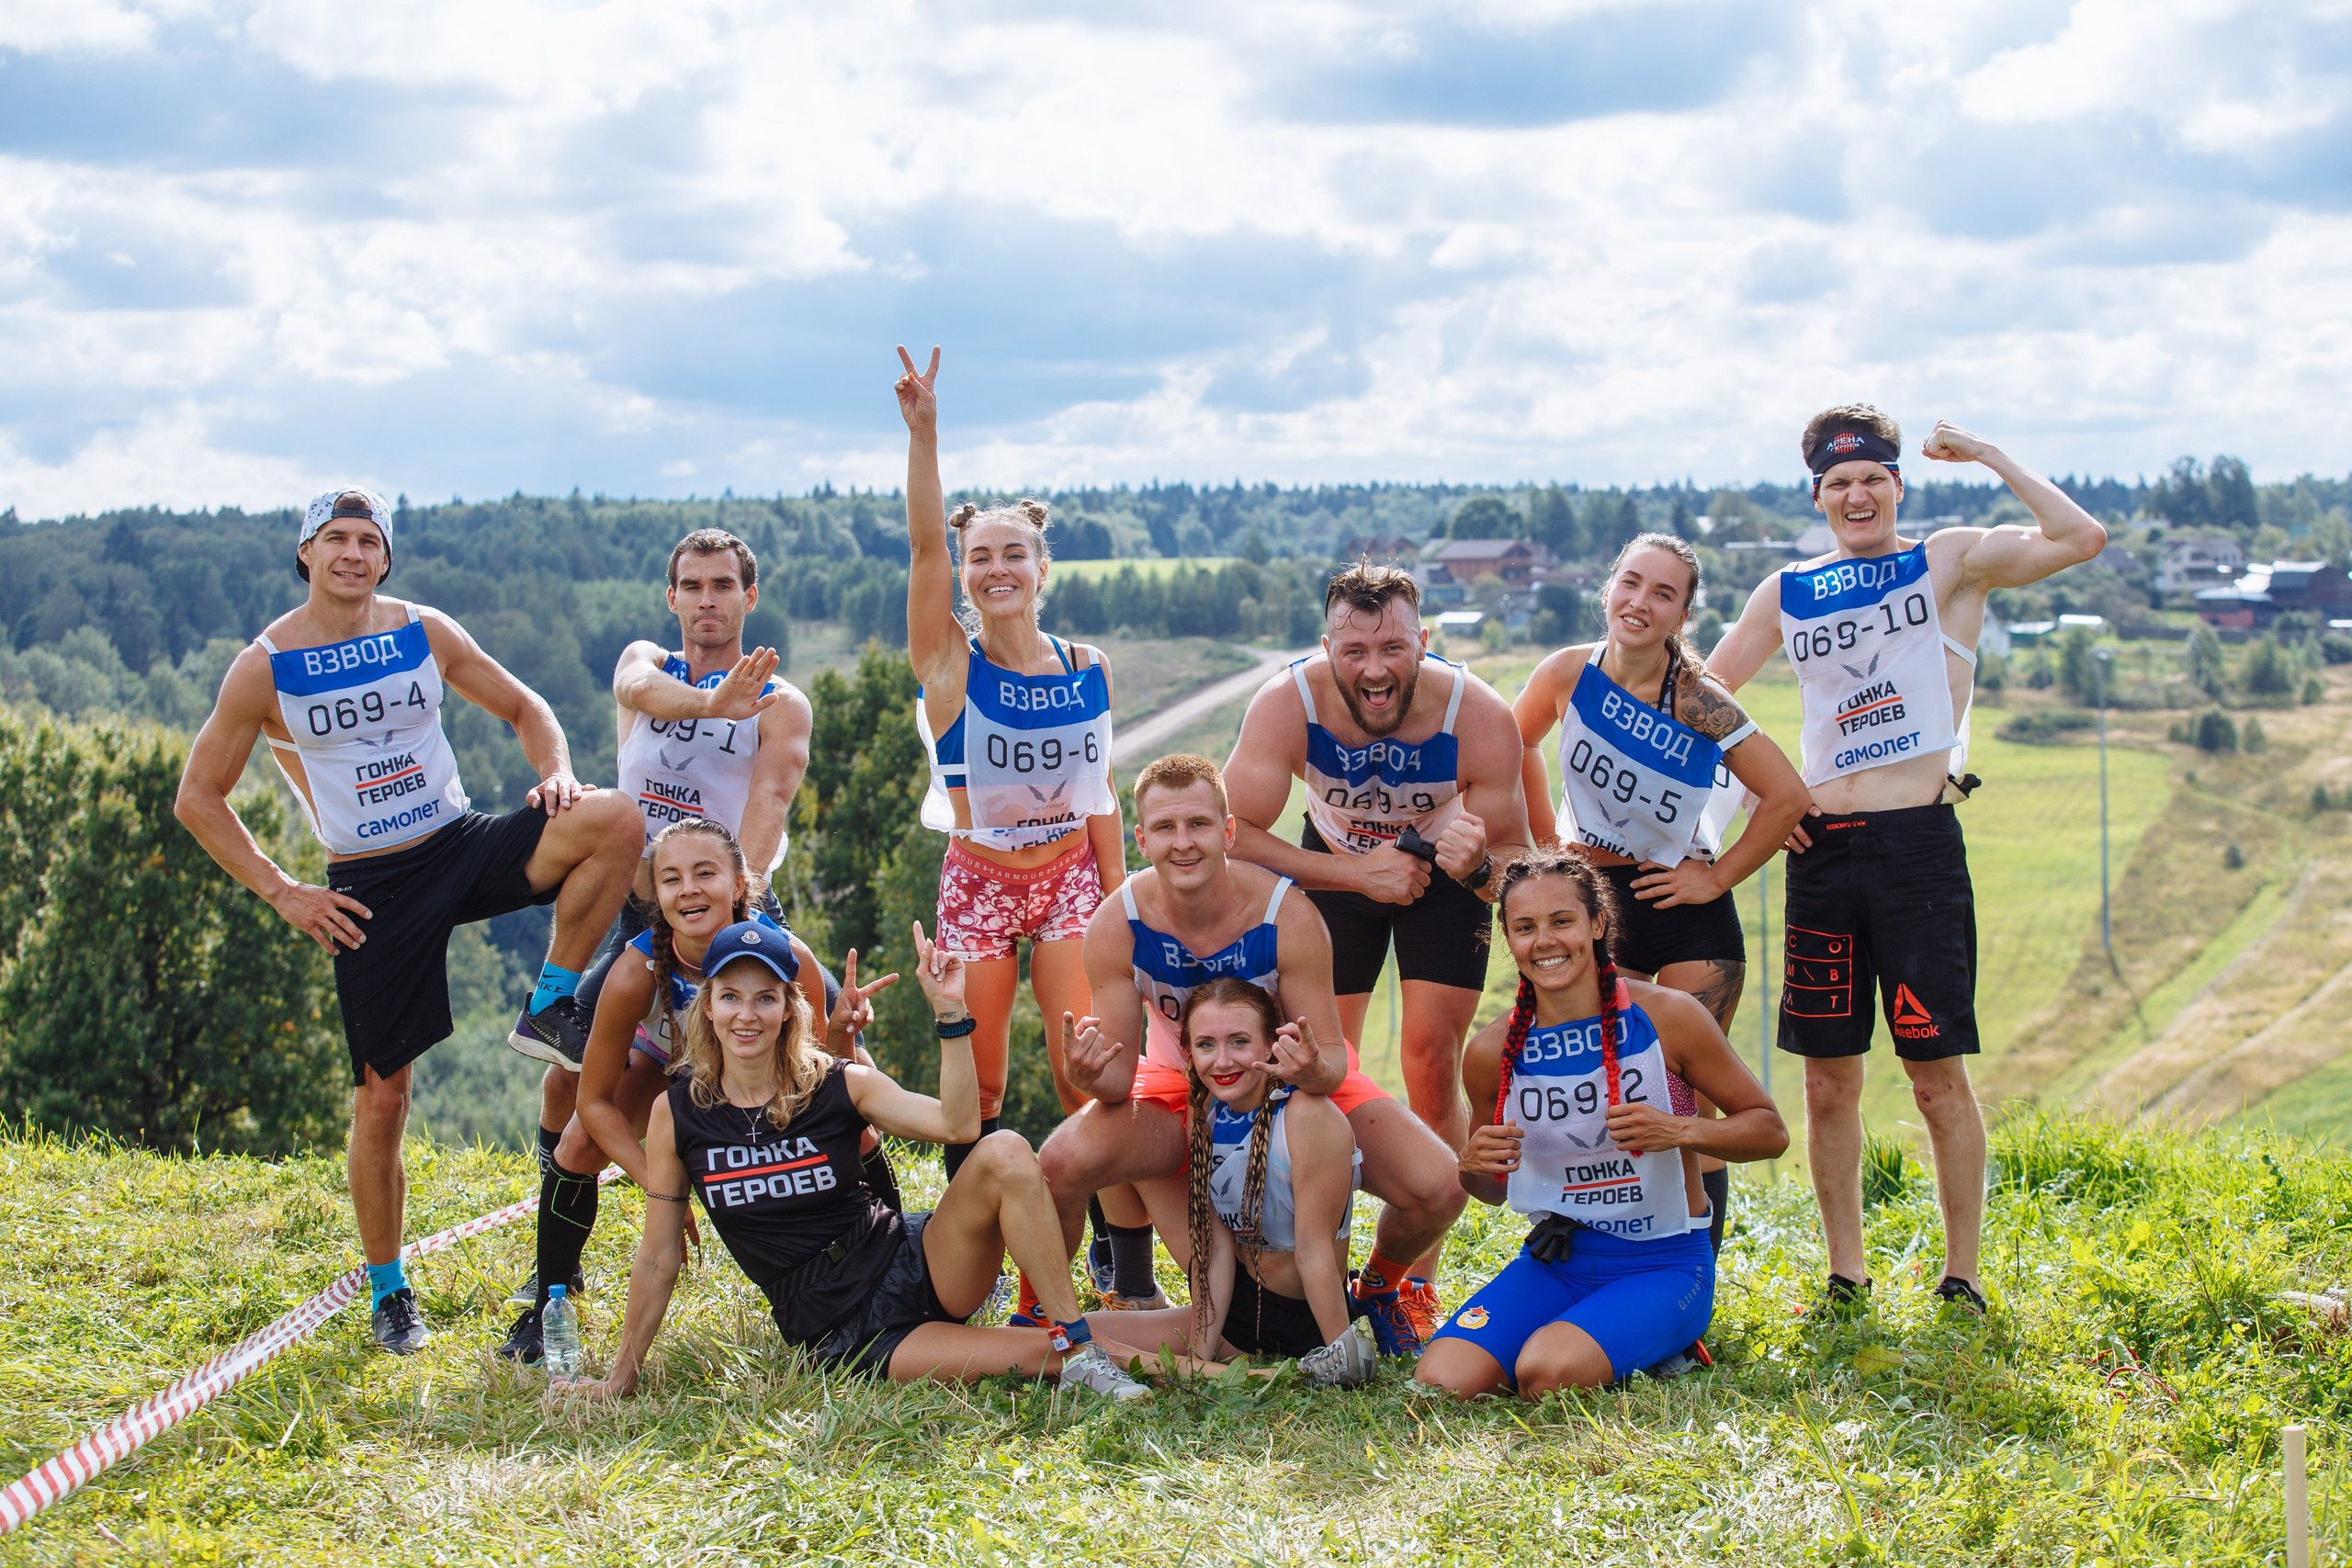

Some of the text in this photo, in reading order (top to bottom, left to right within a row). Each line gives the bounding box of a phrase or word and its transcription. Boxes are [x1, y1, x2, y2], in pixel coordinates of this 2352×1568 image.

[1826, 436, 1865, 450] АРЕНА
[1813, 560, 1896, 601] ВЗВОД
[1792, 593, 1928, 662] 069-10
[304, 635, 402, 675] ВЗВОД
[308, 681, 426, 736] 069-4
[1000, 681, 1085, 711] ВЗВОД
[1838, 680, 1897, 714] ГОНКА
[650, 717, 736, 754] 09-1
[1601, 690, 1694, 767] ВЗВОД
[1838, 704, 1905, 737] ГЕРОЕВ
[988, 732, 1099, 773] 069-6
[1835, 731, 1920, 768] самолет
[356, 752, 416, 782] ГОНКА
[1570, 739, 1682, 824] 069-5
[357, 773, 427, 807] ГЕРОЕВ
[645, 778, 701, 805] ГОНКА
[356, 798, 440, 839] самолет
[1346, 831, 1382, 849] ГЕР
[950, 843, 1088, 880] RMOUR ARMOUR ARMO
[1894, 1023, 1940, 1039] Reebok
[707, 1136, 819, 1171] ГОНКА
[1565, 1158, 1635, 1183] ГОНКА
[706, 1166, 836, 1209] ГЕРОЕВ
[1561, 1185, 1644, 1205] ГЕРОЕВ
[1218, 1213, 1255, 1228] НКА
[1577, 1214, 1654, 1234] молет
